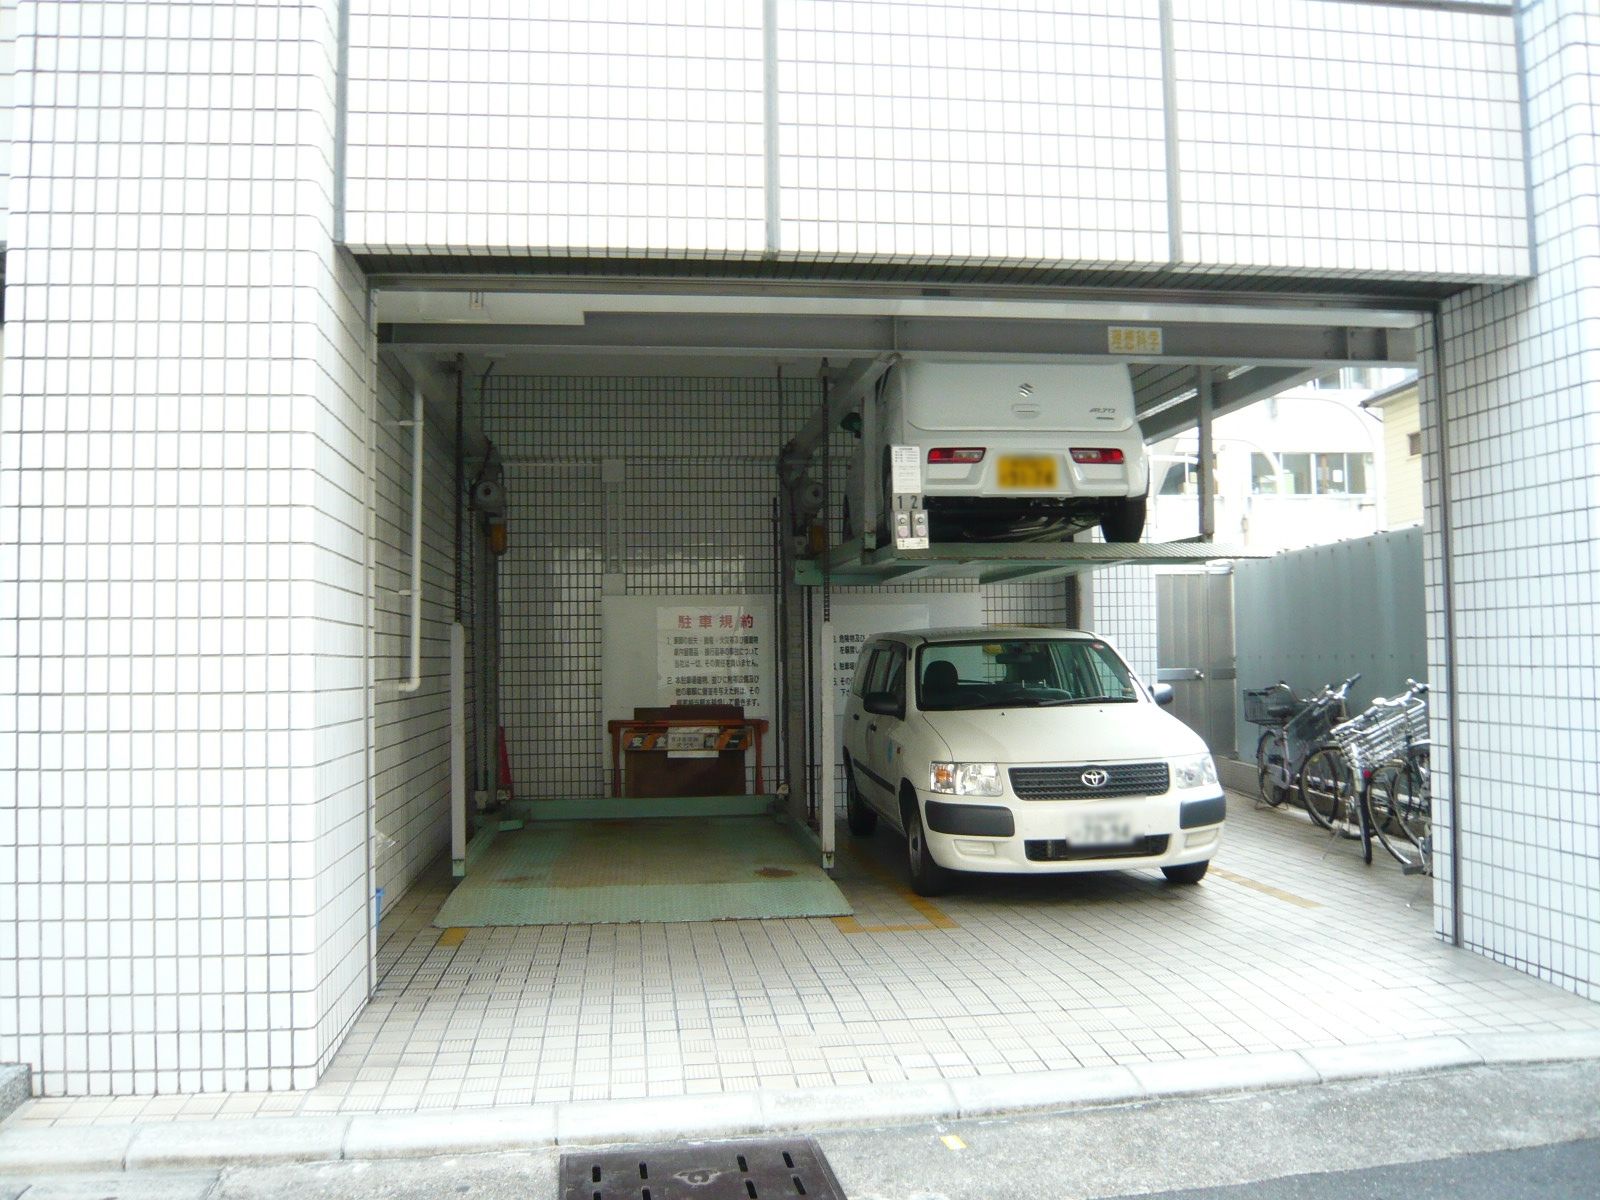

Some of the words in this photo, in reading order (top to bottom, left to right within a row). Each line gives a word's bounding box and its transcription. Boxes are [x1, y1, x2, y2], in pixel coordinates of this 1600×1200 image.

[897, 495, 903, 509] 1
[910, 495, 918, 509] 2
[678, 615, 754, 629] 駐車規約
